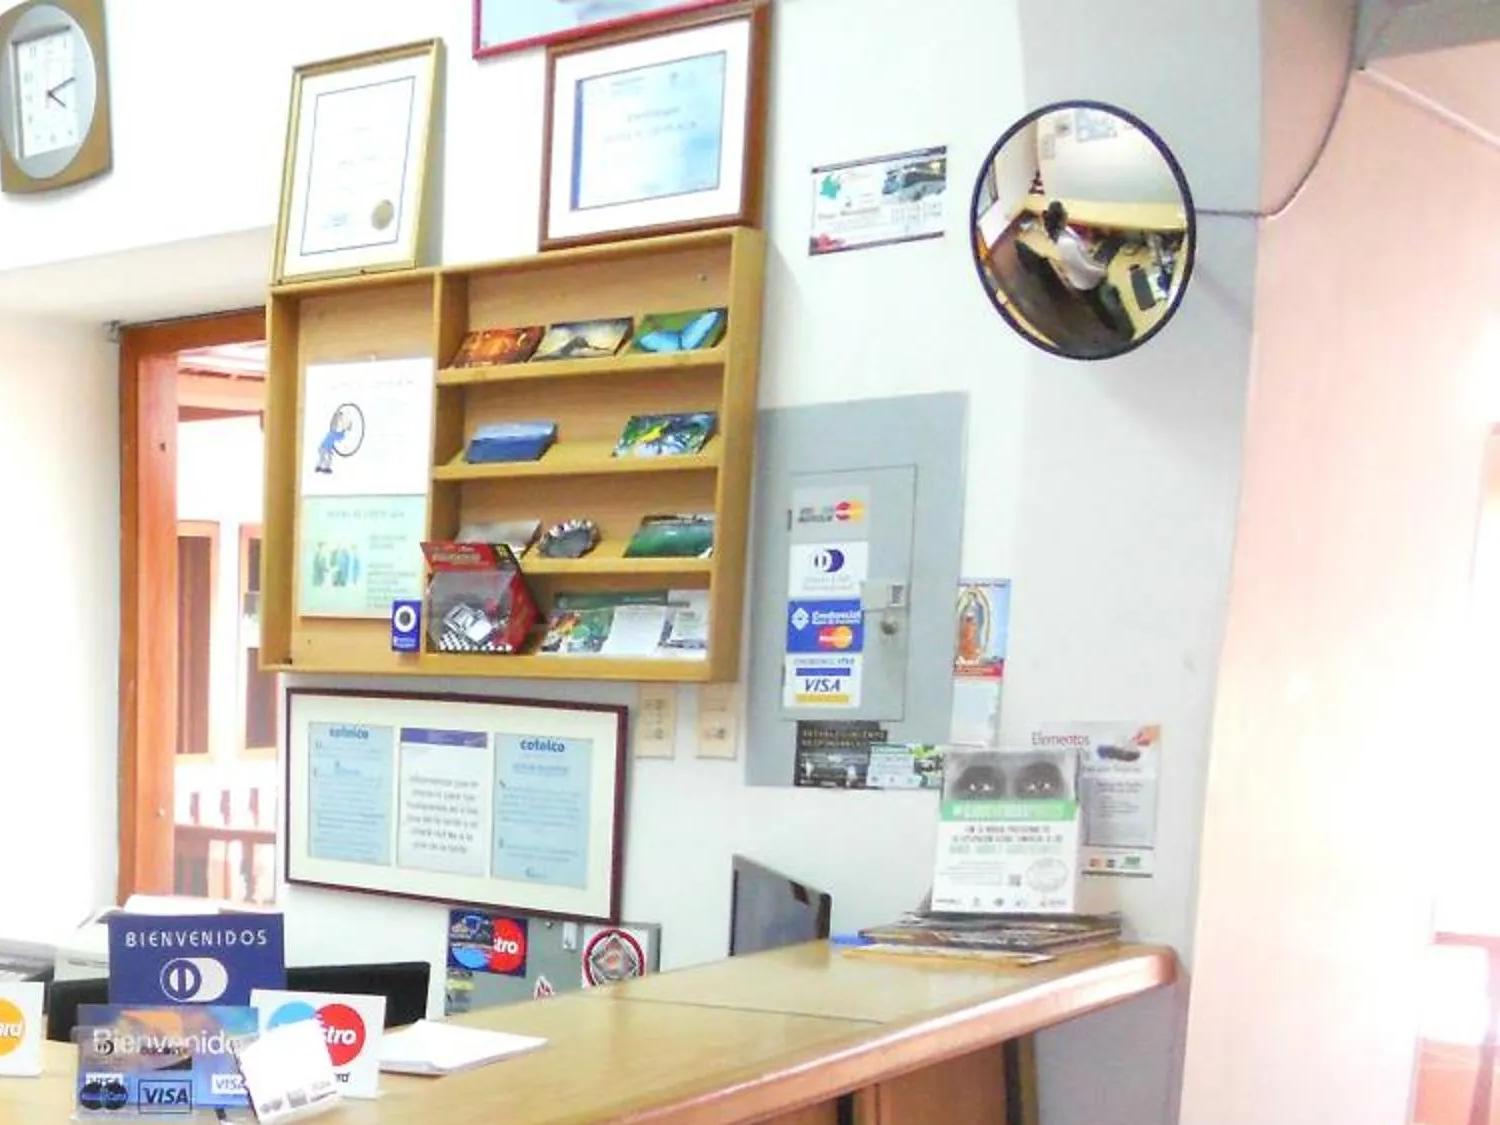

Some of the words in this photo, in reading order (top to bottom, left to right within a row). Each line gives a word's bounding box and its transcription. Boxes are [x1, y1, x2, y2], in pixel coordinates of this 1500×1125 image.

[804, 678, 841, 692] VISA
[124, 928, 268, 948] BIENVENIDOS
[143, 1087, 189, 1104] VISA
